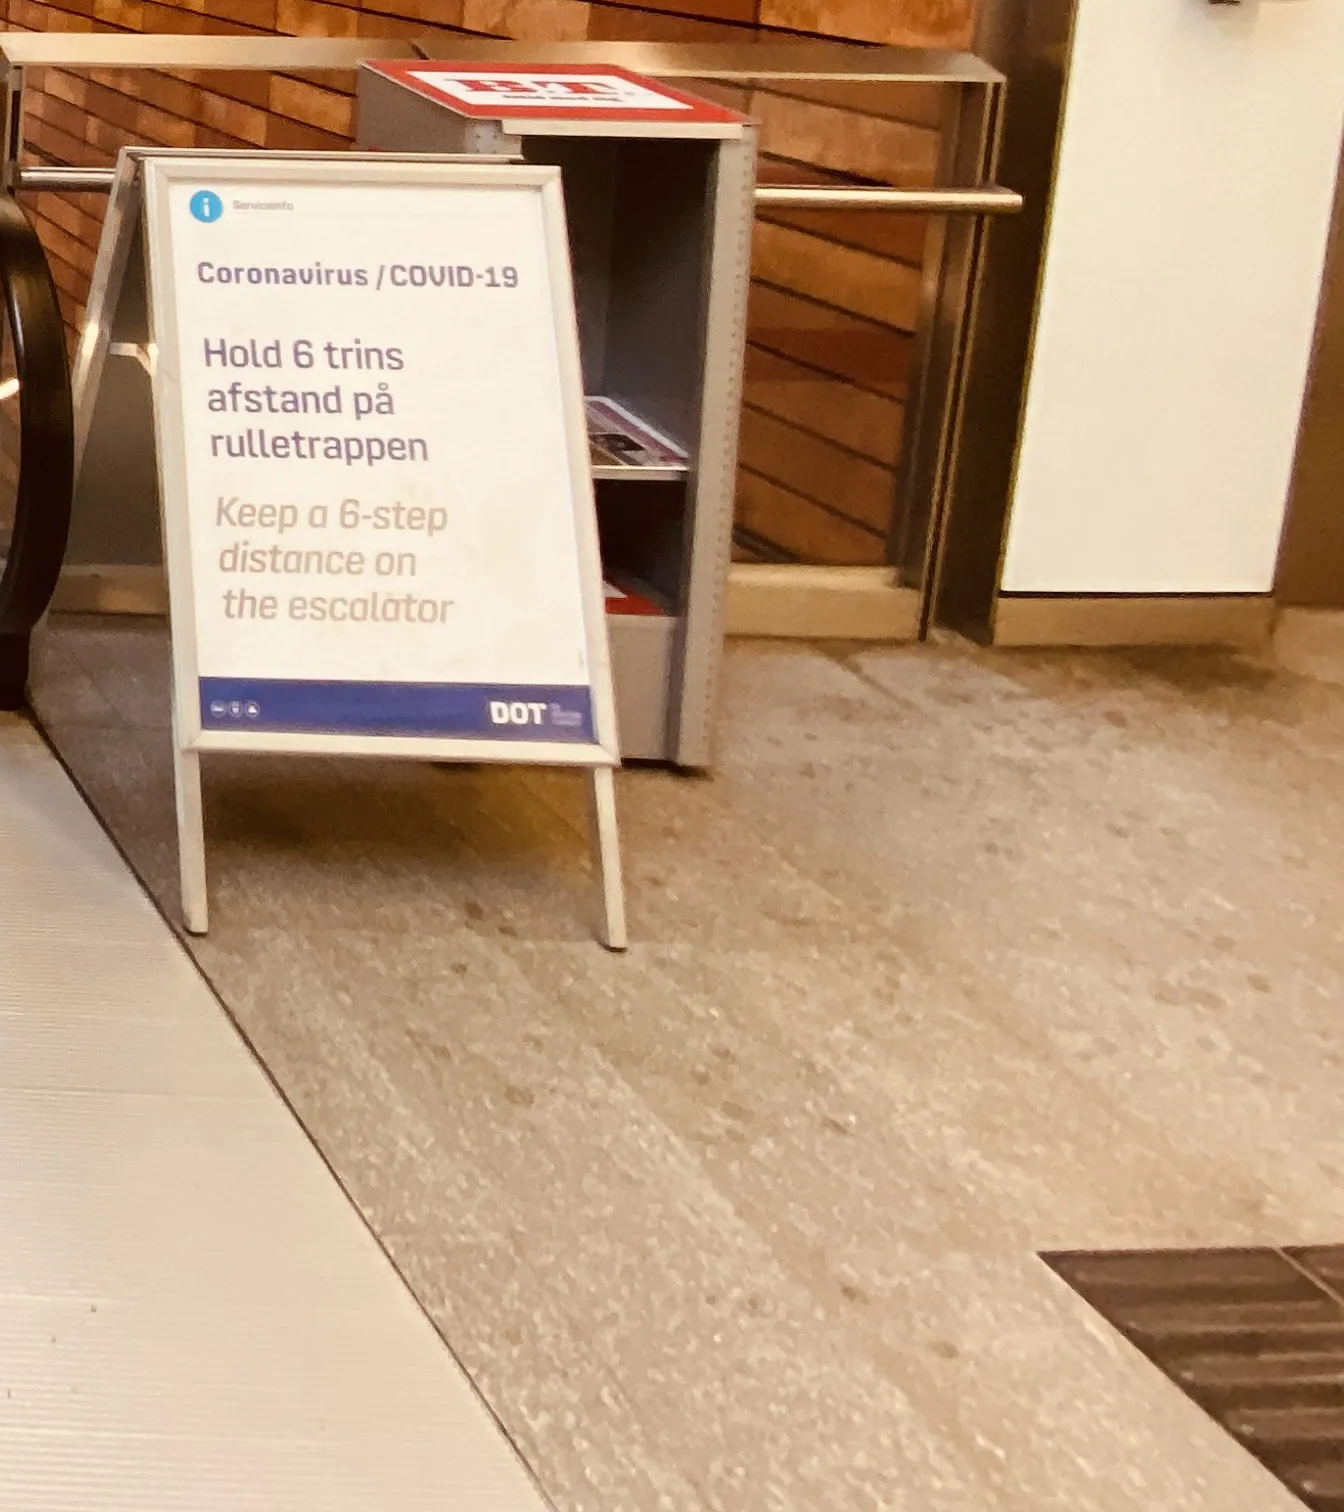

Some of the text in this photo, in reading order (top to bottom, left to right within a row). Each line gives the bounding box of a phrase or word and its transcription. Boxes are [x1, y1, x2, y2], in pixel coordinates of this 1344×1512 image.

[198, 262, 368, 286] Coronavirus
[204, 338, 403, 370] Hold 6 trins
[208, 382, 394, 420] afstand på
[212, 429, 428, 466] rulletrappen
[216, 497, 447, 536] Keep a 6-step
[219, 541, 415, 576] distance on
[223, 588, 454, 623] the escalator
[490, 702, 547, 724] DOT
